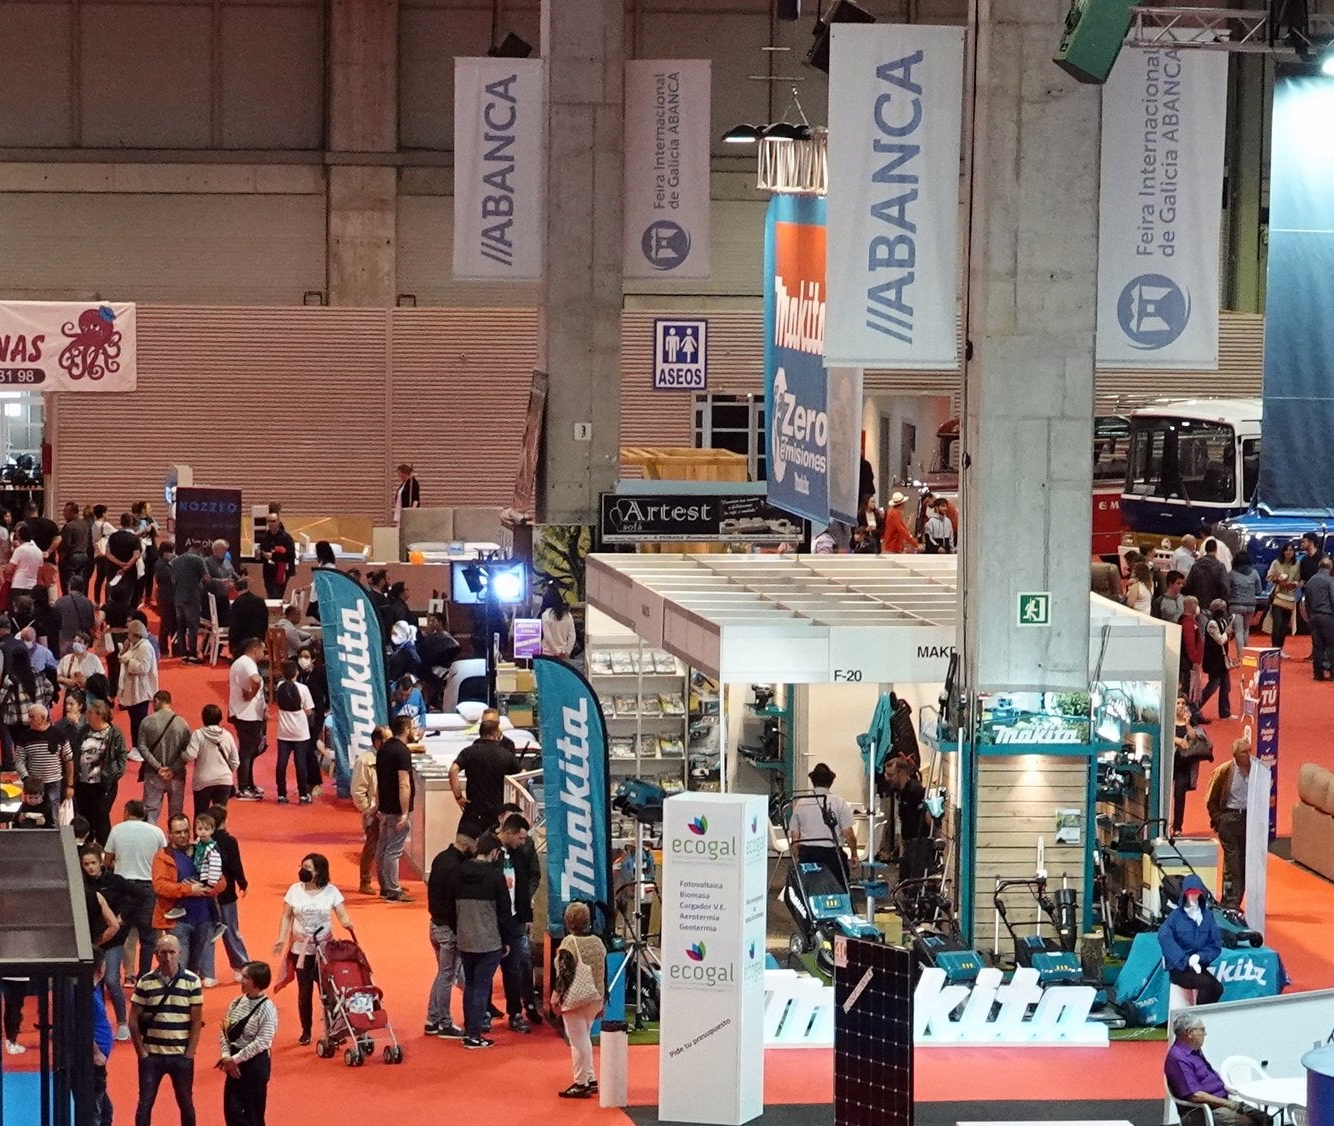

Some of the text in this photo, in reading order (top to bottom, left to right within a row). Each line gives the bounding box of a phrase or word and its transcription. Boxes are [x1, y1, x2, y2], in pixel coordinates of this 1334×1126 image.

[653, 74, 666, 210] Feira Internacional
[668, 71, 681, 210] de Galicia ABANCA
[1136, 46, 1160, 257] Feira Internacional
[1157, 48, 1183, 257] de Galicia ABANCA
[18, 370, 34, 383] 98
[658, 368, 702, 386] ASEOS
[782, 392, 827, 447] Zero
[780, 443, 826, 474] emisiones
[623, 500, 712, 522] Artest
[834, 669, 863, 682] F-20
[992, 724, 1082, 745] makita
[556, 698, 596, 902] makita
[671, 836, 736, 860] ecogal
[679, 879, 724, 890] Fotovoltaica
[679, 891, 711, 900] Biomasa
[679, 902, 711, 913] Cargador
[679, 912, 720, 922] Aerotermia
[679, 923, 717, 932] Geotermia
[669, 962, 734, 987] ecogal
[764, 967, 1110, 1047] mkita
[668, 1046, 684, 1058] Pide
